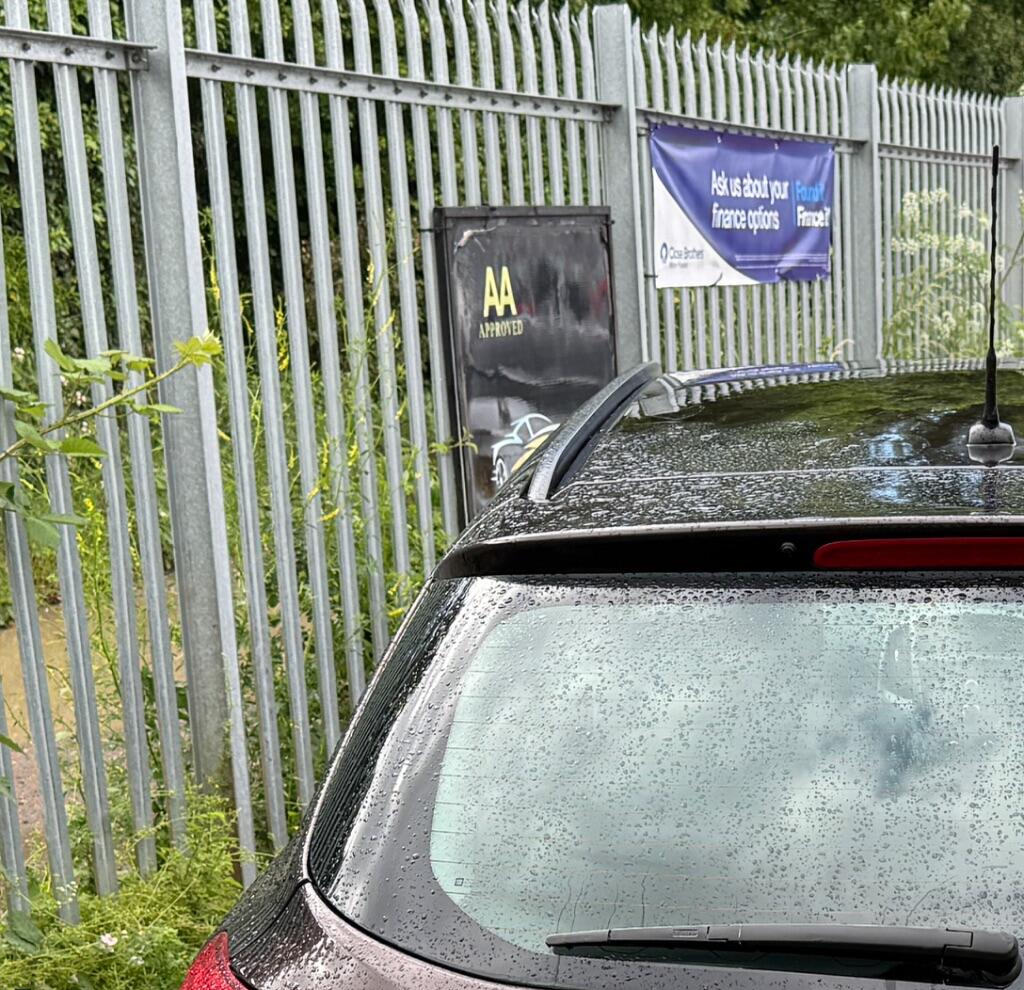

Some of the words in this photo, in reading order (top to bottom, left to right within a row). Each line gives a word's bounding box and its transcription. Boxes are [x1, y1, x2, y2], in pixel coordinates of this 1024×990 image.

[711, 168, 729, 196] Ask
[730, 176, 741, 198] us
[743, 170, 769, 199] about
[769, 180, 789, 205] your
[712, 202, 746, 230] finance
[748, 205, 780, 235] options
[483, 266, 518, 318] AA
[478, 319, 524, 339] APPROVED
